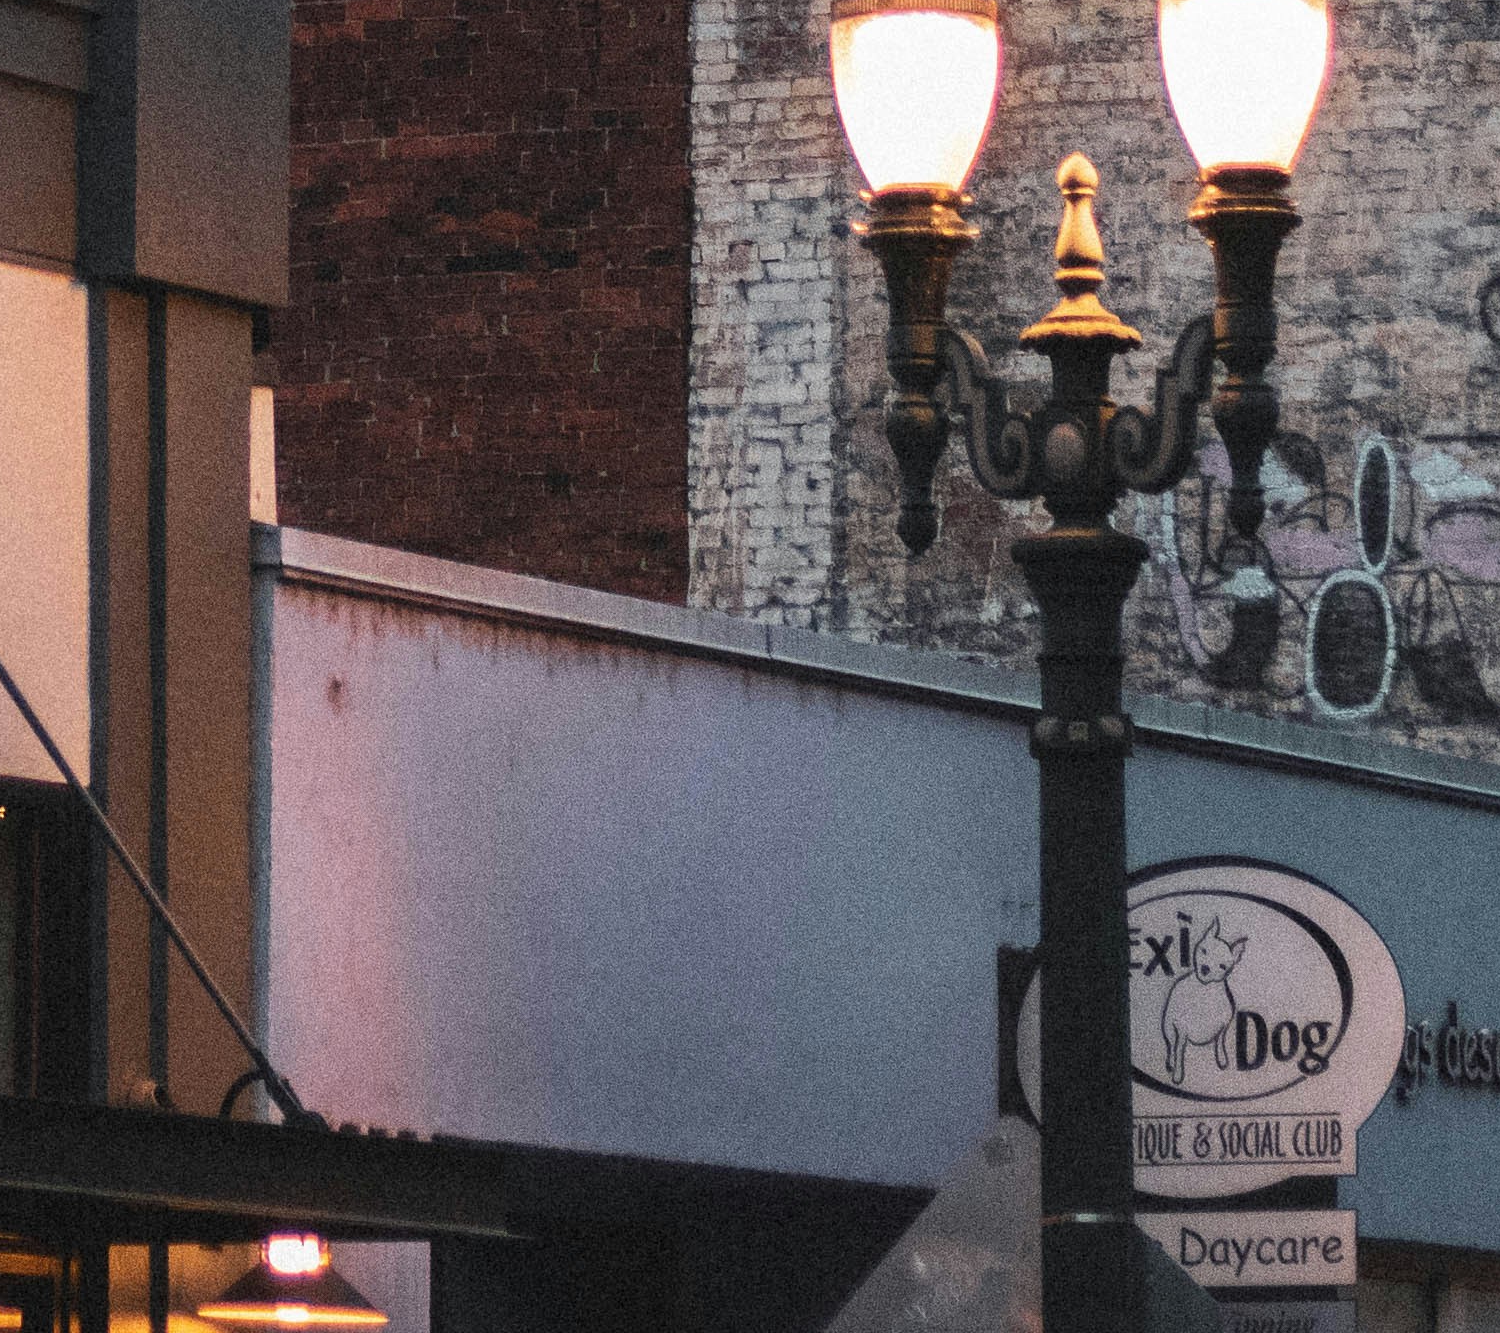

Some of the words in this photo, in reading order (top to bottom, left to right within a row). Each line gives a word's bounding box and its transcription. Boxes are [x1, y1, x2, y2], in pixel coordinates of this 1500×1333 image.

[1236, 1010, 1333, 1076] Dog
[1192, 1122, 1213, 1158] &
[1219, 1121, 1287, 1159] SOCIAL
[1292, 1120, 1342, 1157] CLUB
[1179, 1227, 1344, 1277] Daycare
